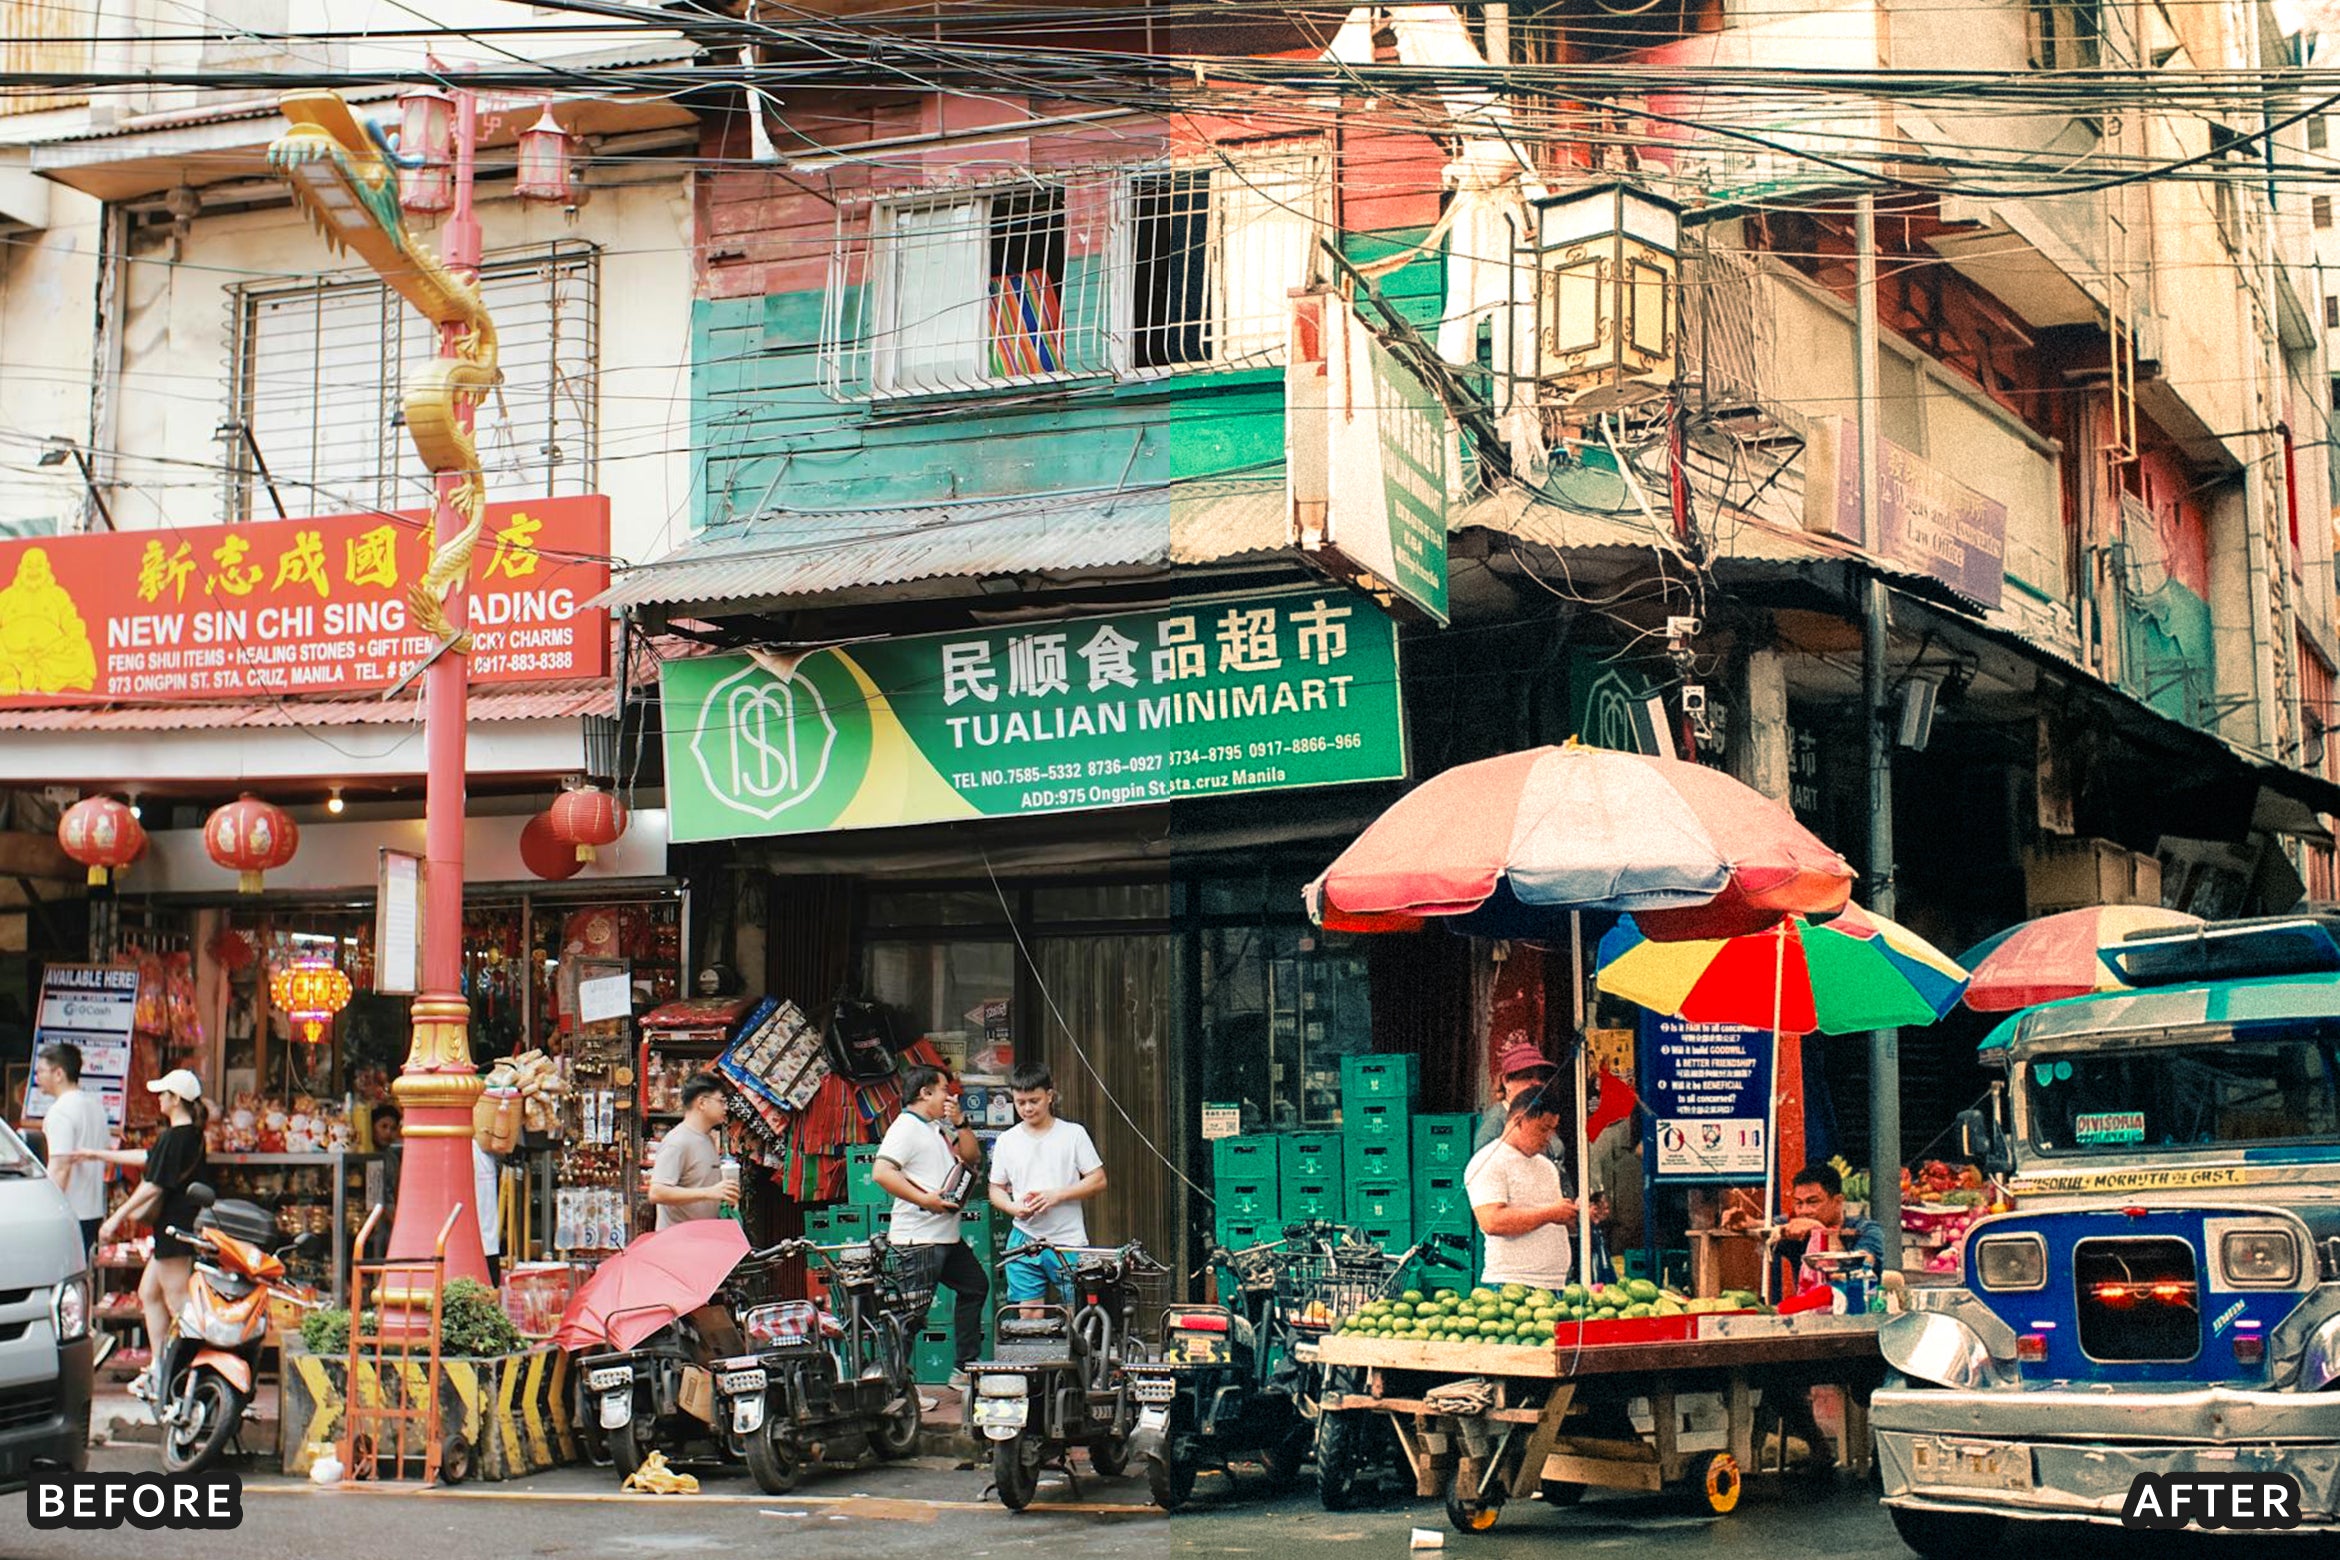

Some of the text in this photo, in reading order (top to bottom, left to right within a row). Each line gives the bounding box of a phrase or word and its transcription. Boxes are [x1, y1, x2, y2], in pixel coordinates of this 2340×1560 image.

[137, 513, 543, 604] 新志成國店
[108, 588, 575, 649] NEW SIN CHI SING ADING
[108, 653, 145, 673] FENG
[148, 650, 181, 670] SHUI
[183, 647, 225, 668] ITEMS
[236, 644, 297, 666] HEALING
[300, 641, 355, 662] STONES
[367, 637, 400, 658] GIFT
[510, 627, 573, 648] CHARMS
[108, 676, 131, 695] 973
[134, 673, 187, 692] ONGPIN
[190, 671, 210, 690] ST.
[213, 669, 244, 689] STA.
[246, 668, 288, 688] CRUZ,
[291, 663, 344, 685] MANILA
[354, 661, 384, 682] TEL.
[474, 650, 573, 675] 0917-883-8388
[942, 600, 1353, 706] 民顺食品超市
[945, 675, 1354, 748] TUALIAN MINIMART
[953, 772, 979, 789] TEL
[1088, 754, 1163, 776] 8736-0927
[1248, 733, 1361, 758] 0917-8866-966
[1021, 787, 1086, 808] ADD:975
[1089, 782, 1145, 803] Ongpin
[1232, 766, 1286, 786] Manila
[45, 968, 136, 989] AVAILABLE HERE!
[1683, 1058, 1710, 1067] BETTER
[1710, 1045, 1746, 1054] GOODWILL
[1702, 1081, 1744, 1090] BENEFICIAL
[2078, 1115, 2142, 1132] DIVISORIA
